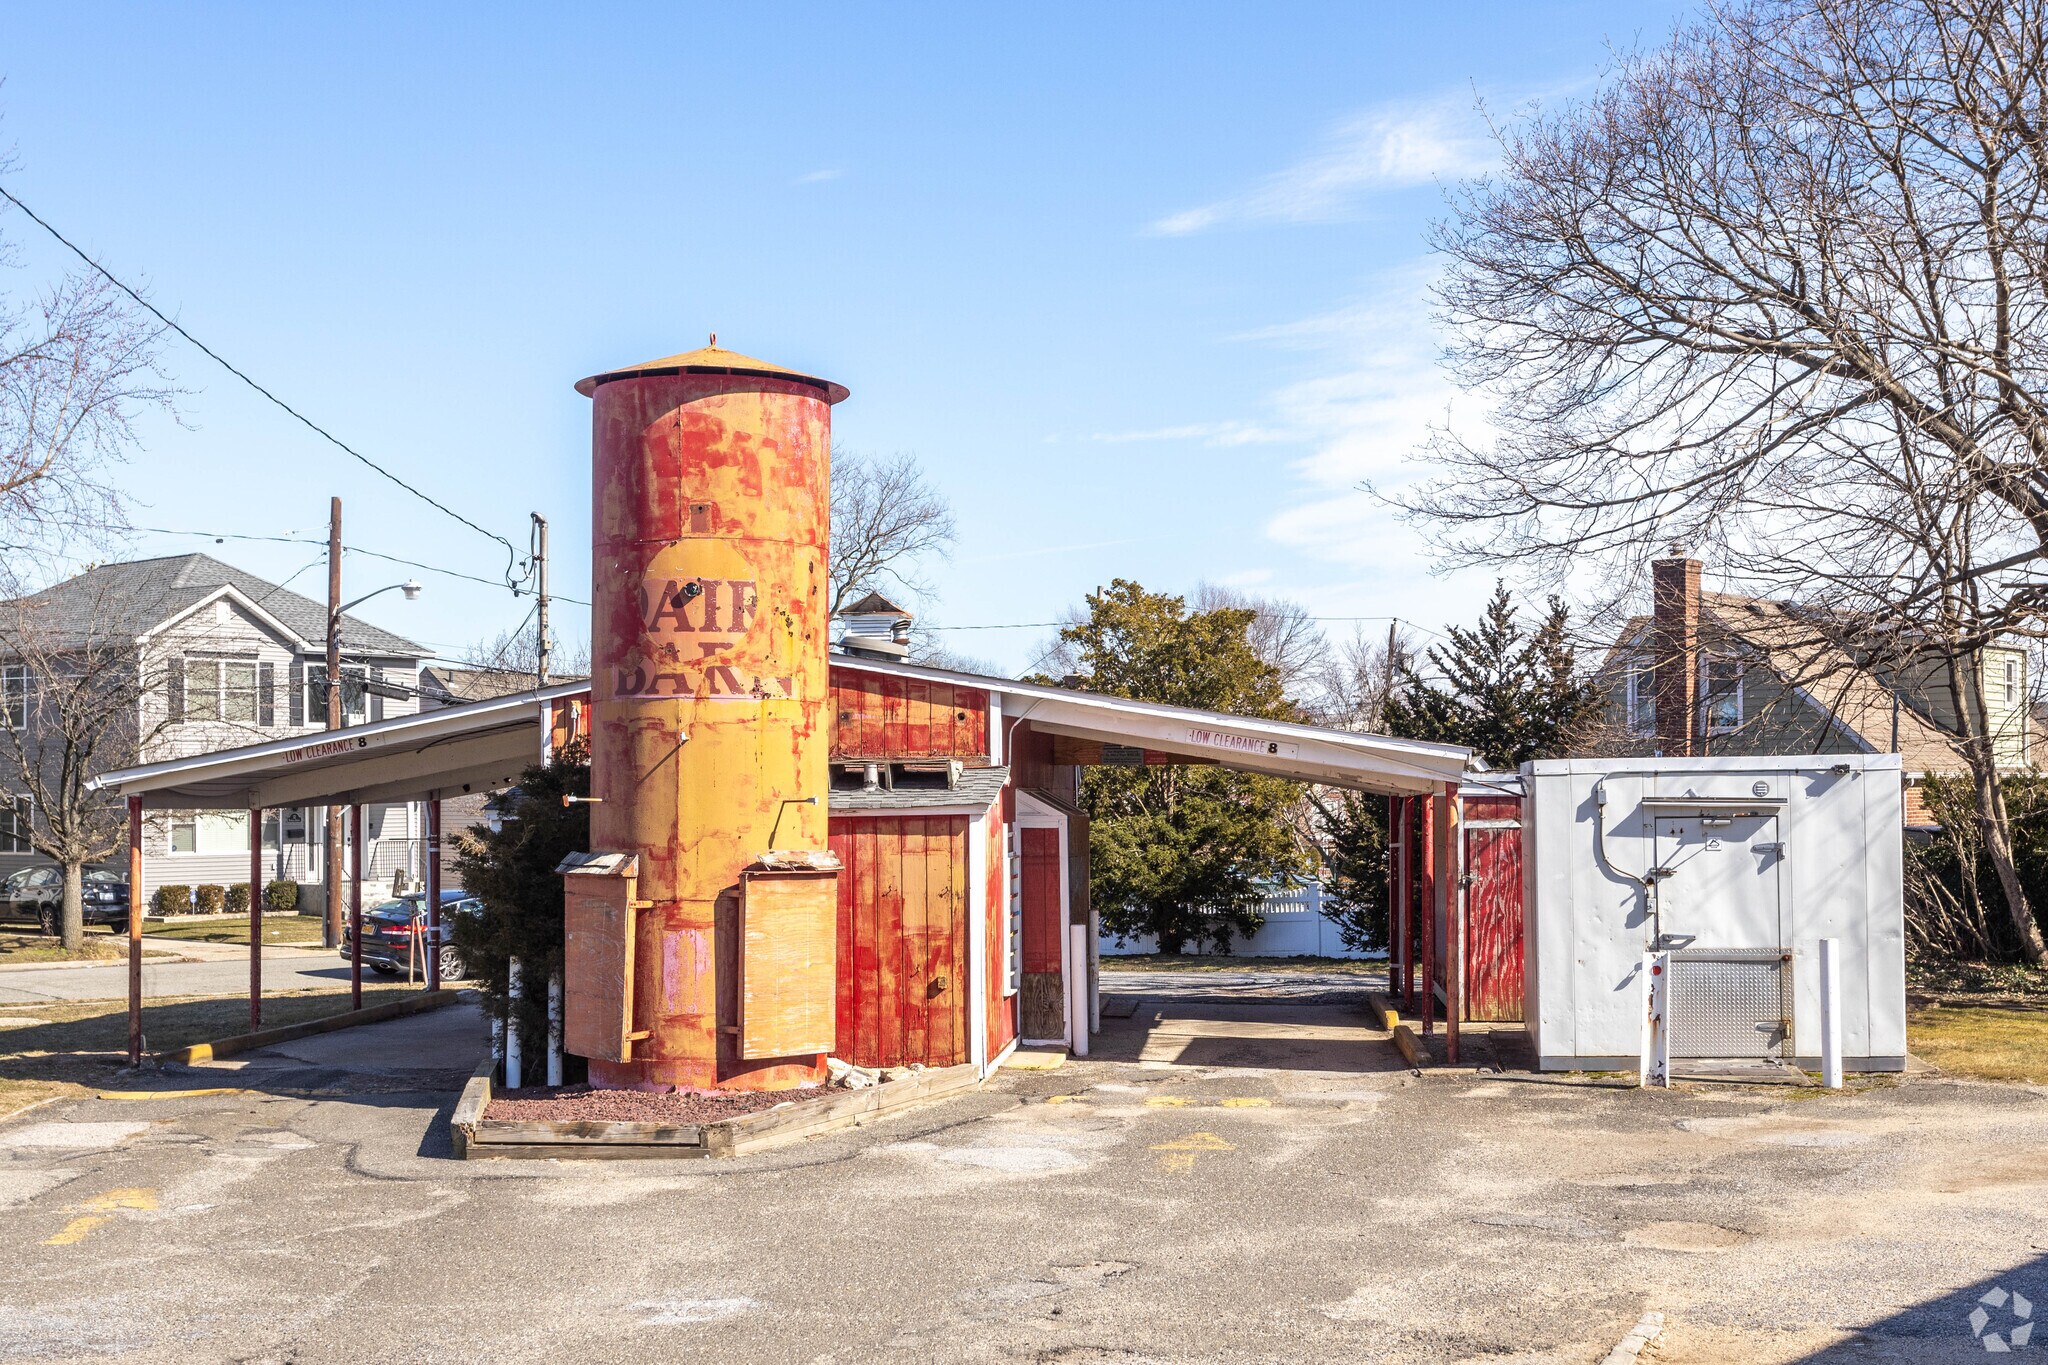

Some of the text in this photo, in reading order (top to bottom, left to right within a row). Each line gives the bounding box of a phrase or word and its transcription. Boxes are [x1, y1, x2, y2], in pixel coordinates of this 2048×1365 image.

[286, 737, 367, 762] LOW CLEARANCE 8
[1191, 730, 1278, 754] LOW CLEARANCE 8
